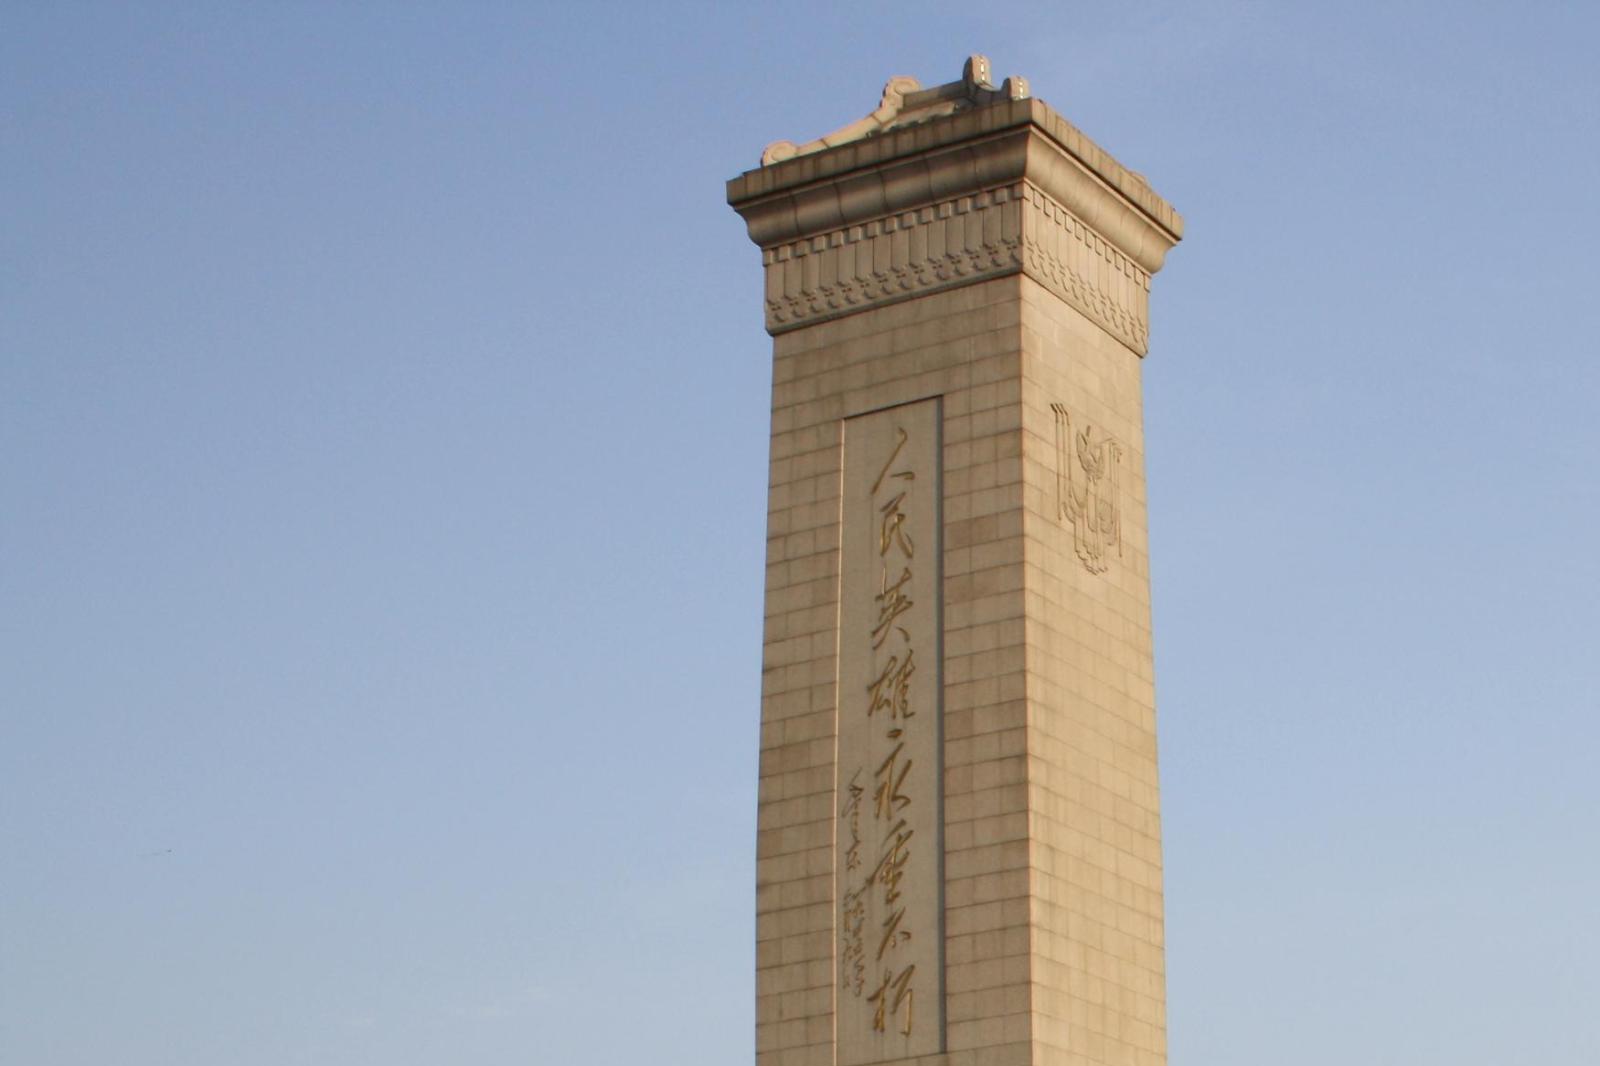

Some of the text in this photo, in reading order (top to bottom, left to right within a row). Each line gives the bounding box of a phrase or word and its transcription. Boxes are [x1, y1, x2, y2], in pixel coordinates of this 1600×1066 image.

[865, 426, 916, 1037] 人民英雄永垂不朽
